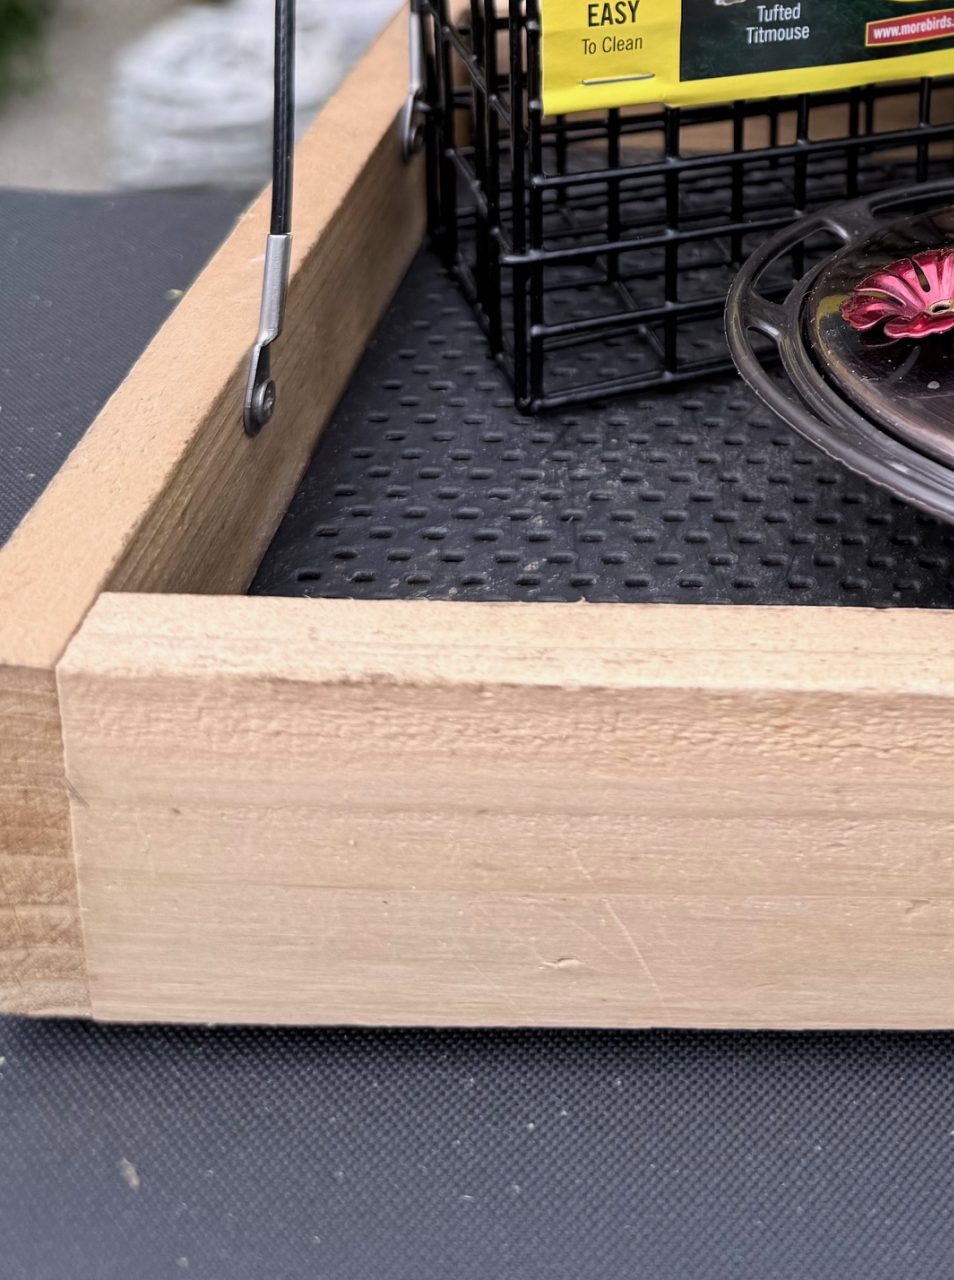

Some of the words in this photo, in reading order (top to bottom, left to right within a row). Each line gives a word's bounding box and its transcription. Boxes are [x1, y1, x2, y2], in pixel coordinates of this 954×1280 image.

[587, 0, 640, 27] EASY
[756, 3, 801, 23] Tufted
[581, 38, 597, 55] To
[602, 35, 643, 53] Clean
[745, 25, 810, 45] Titmouse
